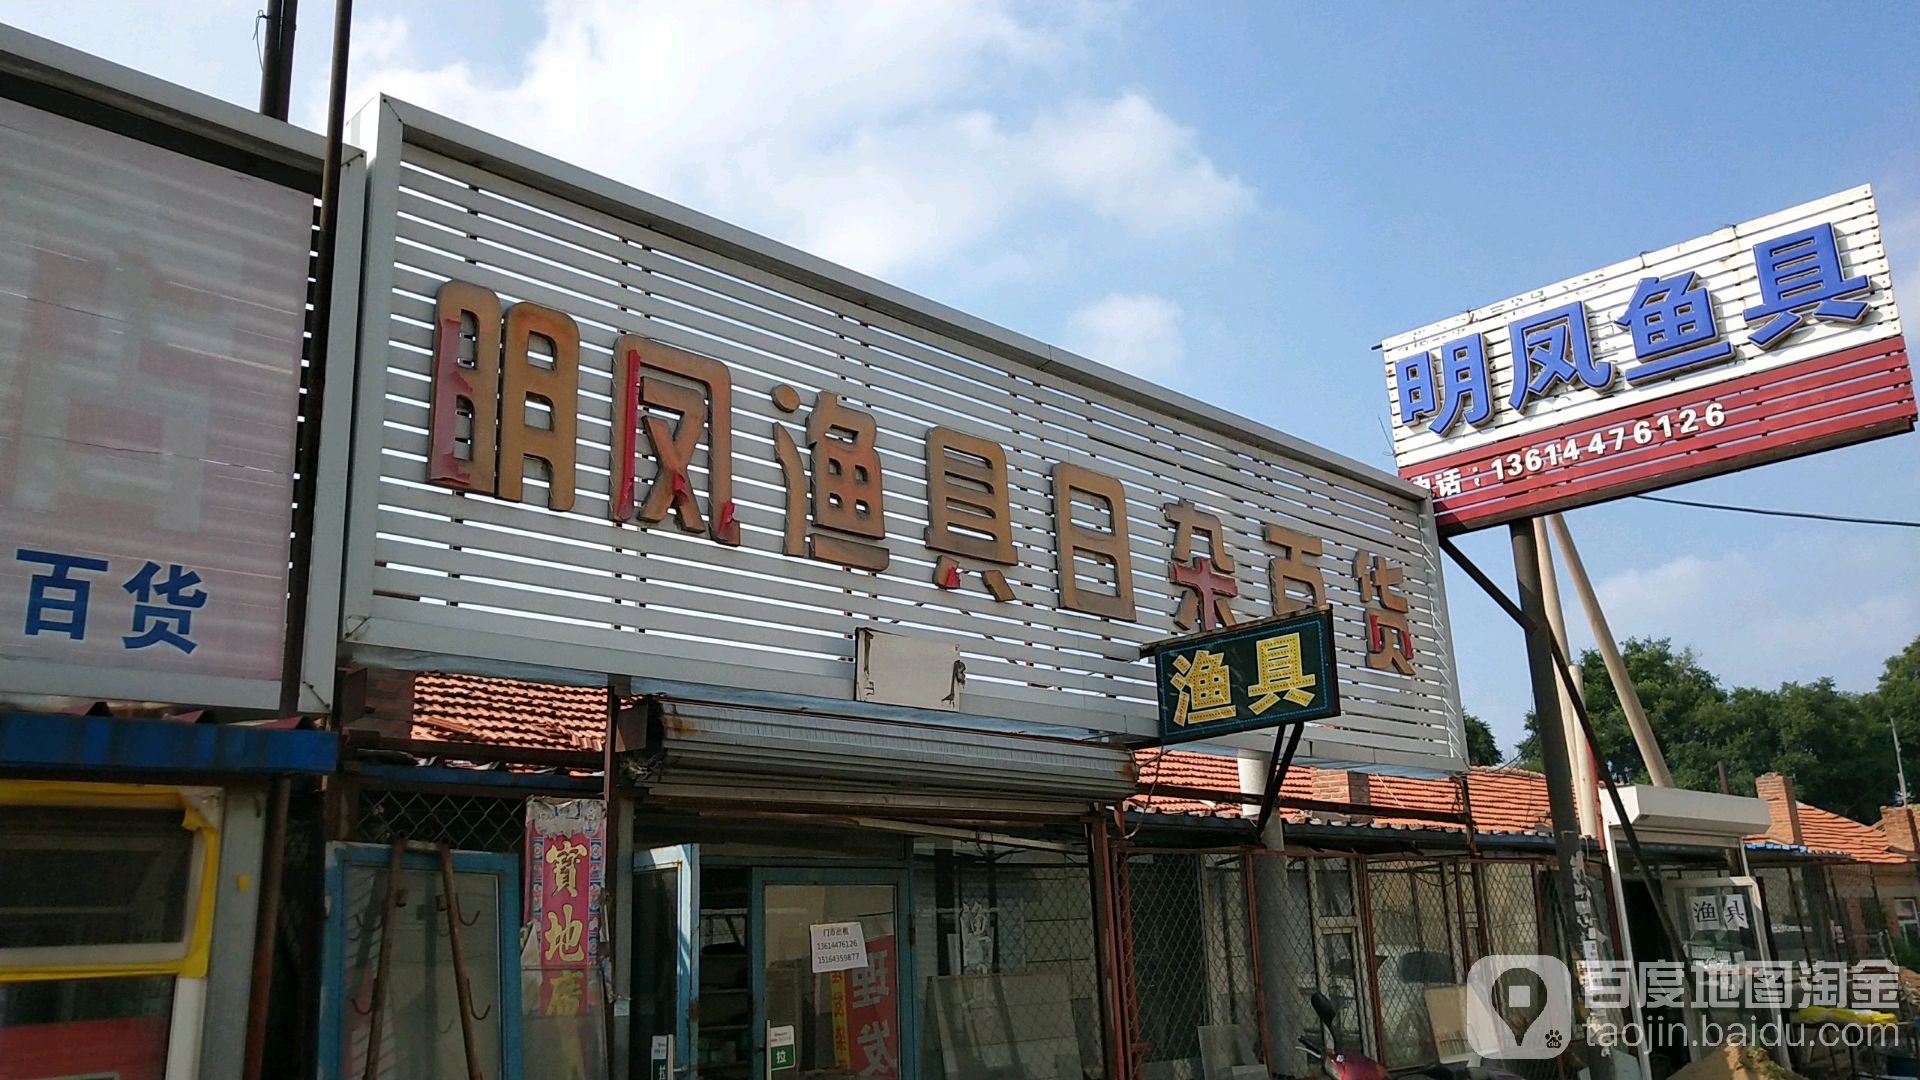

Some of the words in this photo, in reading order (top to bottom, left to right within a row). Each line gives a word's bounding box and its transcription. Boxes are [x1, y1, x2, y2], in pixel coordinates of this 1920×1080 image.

[1394, 221, 1872, 437] 明凤鱼具
[15, 547, 208, 654] 百货
[1169, 631, 1317, 727] 渔具
[1692, 900, 1745, 923] 渔具
